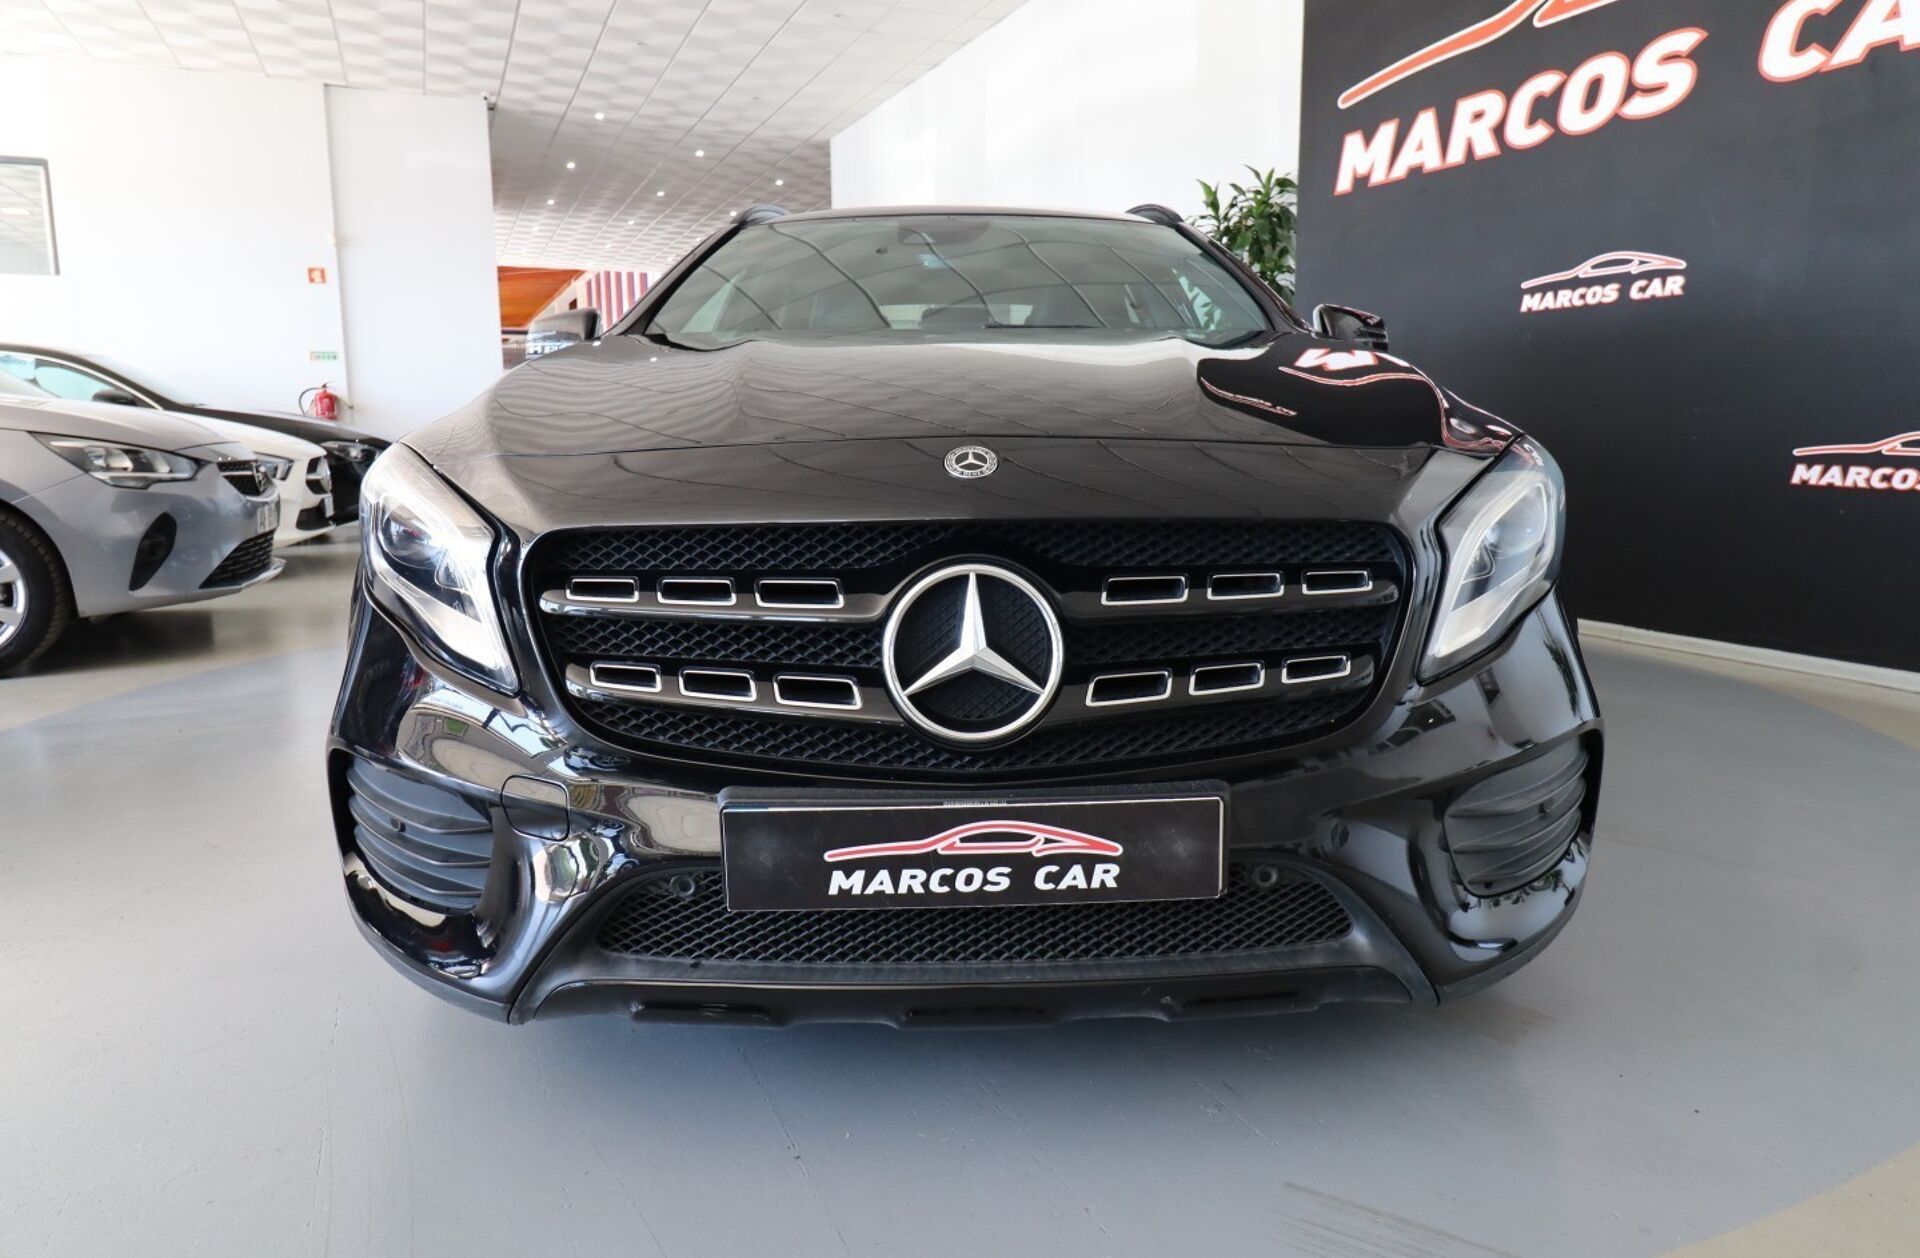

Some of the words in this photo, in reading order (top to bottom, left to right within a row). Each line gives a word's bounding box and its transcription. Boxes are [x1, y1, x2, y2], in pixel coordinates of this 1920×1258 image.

[1333, 27, 1708, 196] MARCOS
[1520, 283, 1621, 312] MARCOS
[1629, 275, 1686, 300] CAR
[1790, 463, 1920, 490] MARCO
[828, 866, 1012, 895] MARCOS
[1033, 863, 1120, 890] CAR
